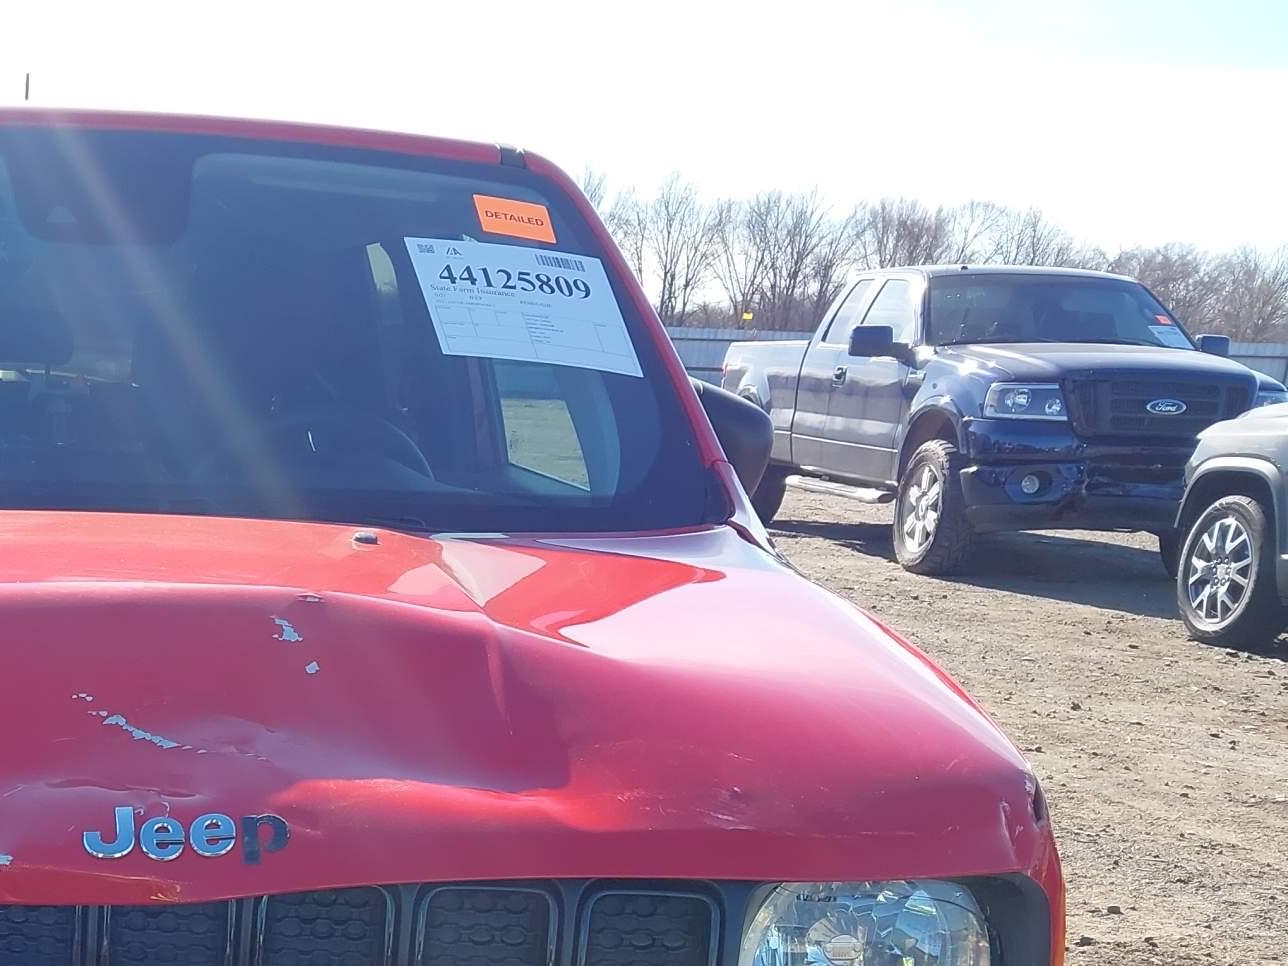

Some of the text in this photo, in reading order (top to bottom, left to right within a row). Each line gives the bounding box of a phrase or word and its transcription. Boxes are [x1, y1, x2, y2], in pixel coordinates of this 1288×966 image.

[485, 210, 544, 226] DETAILED
[439, 264, 591, 300] 44125809
[1153, 399, 1180, 412] Ford
[83, 807, 291, 865] Jeep
